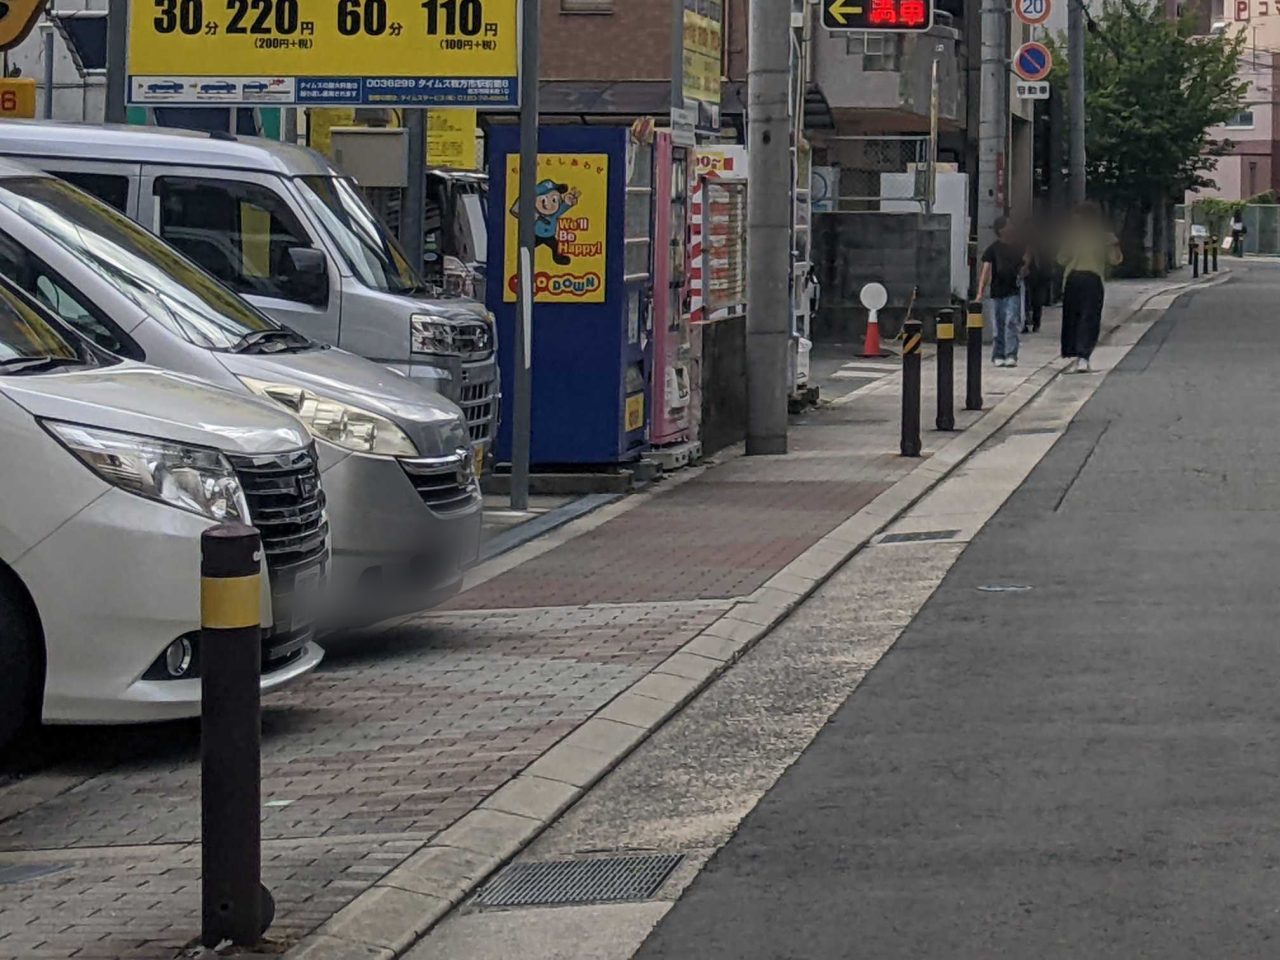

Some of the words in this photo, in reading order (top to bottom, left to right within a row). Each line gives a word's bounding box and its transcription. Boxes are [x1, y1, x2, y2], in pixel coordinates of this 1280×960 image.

[1237, 1, 1248, 19] P
[558, 218, 588, 230] We'll
[558, 232, 575, 242] Be
[558, 241, 602, 256] Happy!
[551, 276, 597, 292] DOWN
